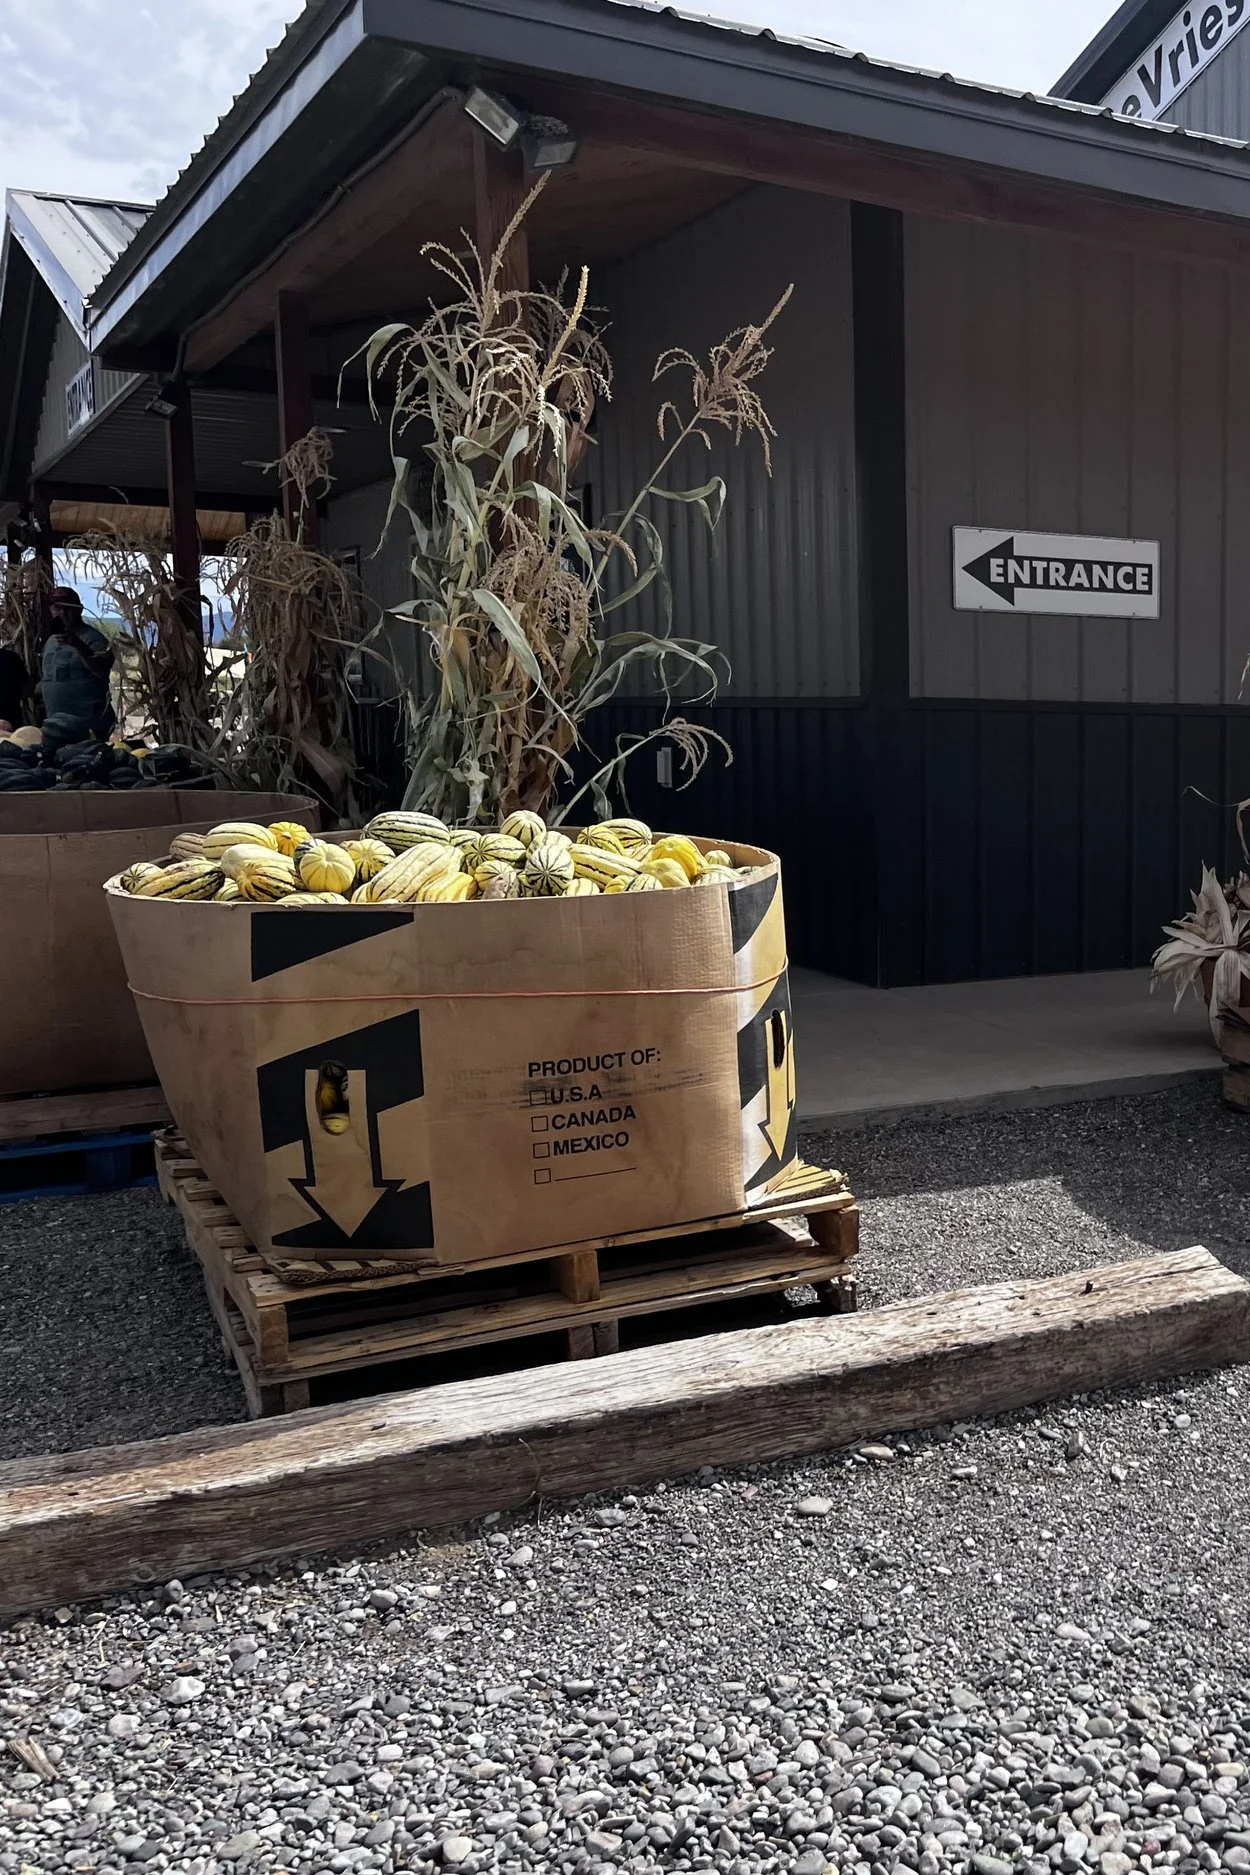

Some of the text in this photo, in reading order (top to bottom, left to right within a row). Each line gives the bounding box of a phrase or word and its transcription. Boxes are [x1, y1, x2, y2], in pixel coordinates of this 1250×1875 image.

[989, 557, 1150, 592] ENTRANCE
[528, 1048, 661, 1078] PRODUCT OF:
[551, 1084, 602, 1105] U.S.A
[551, 1105, 636, 1130] CANADA
[553, 1131, 630, 1156] MEXICO
